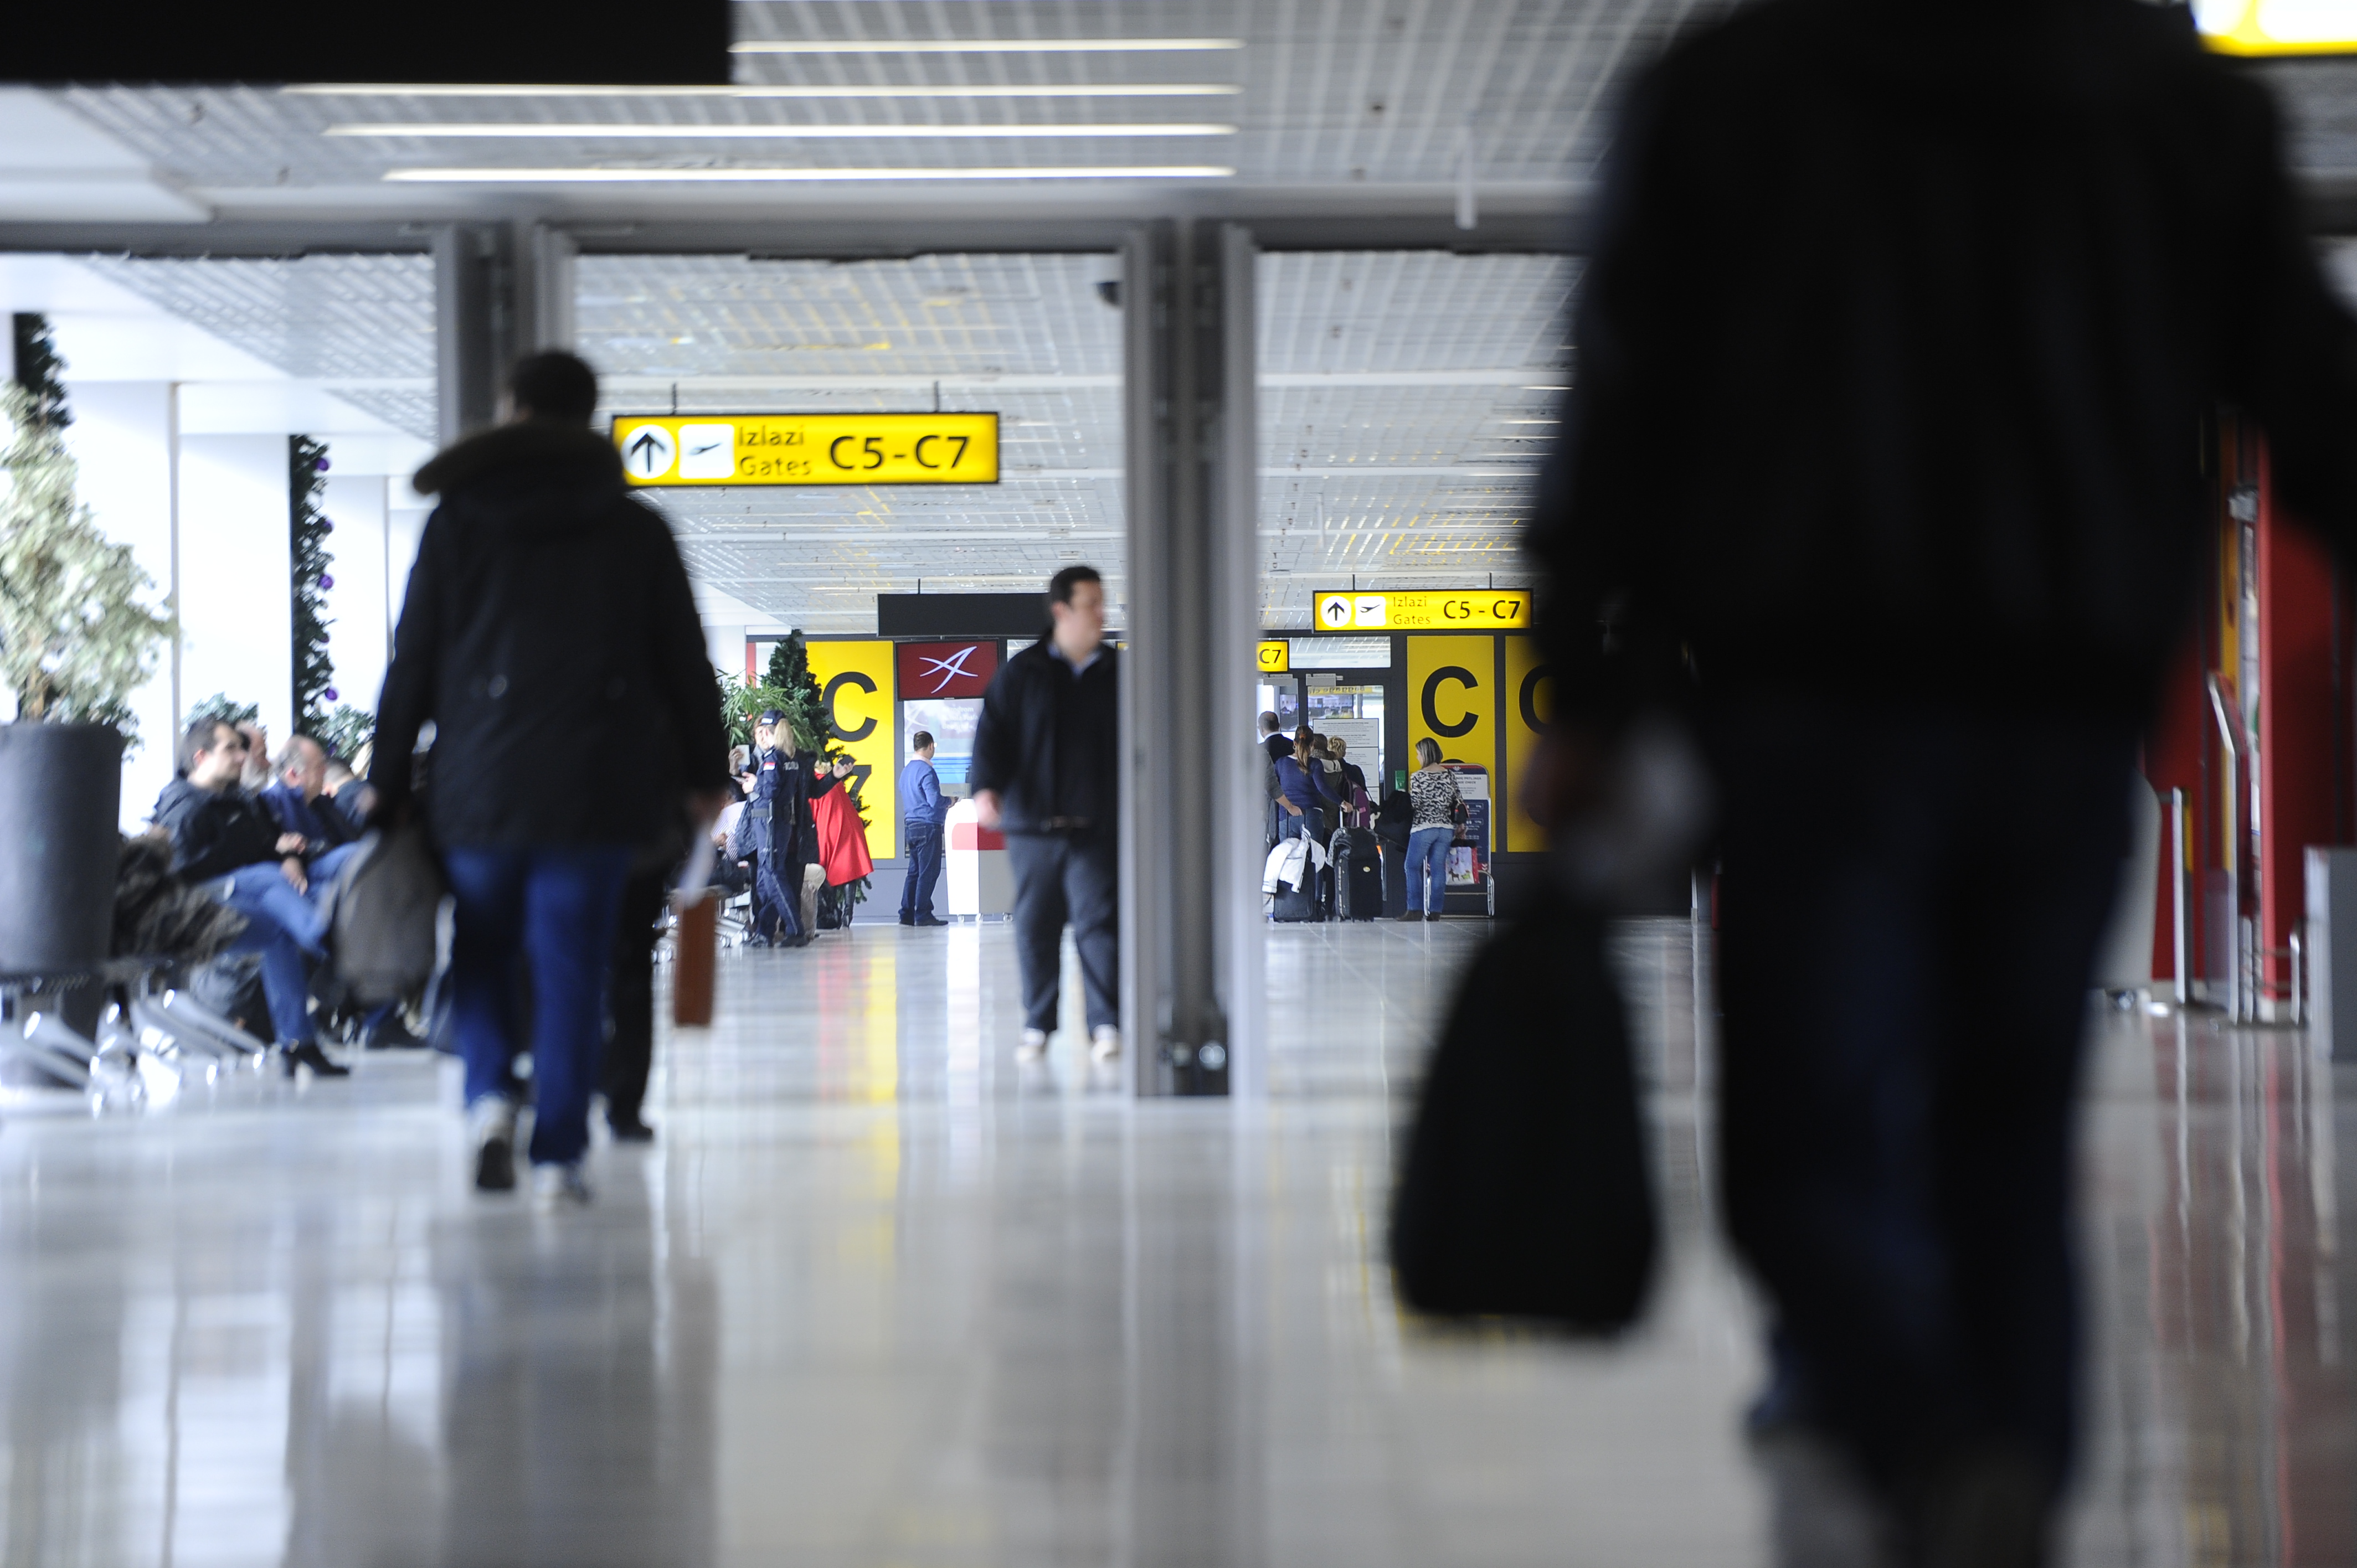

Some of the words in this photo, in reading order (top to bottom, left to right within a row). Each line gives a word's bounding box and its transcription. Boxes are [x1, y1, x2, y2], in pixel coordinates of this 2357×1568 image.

[739, 425, 804, 446] Izlazi
[740, 456, 812, 476] Gates
[1393, 596, 1427, 607] Izlazi
[1393, 614, 1430, 625] Gates
[1259, 648, 1282, 664] C7
[822, 671, 878, 742] C
[1421, 666, 1479, 737] C
